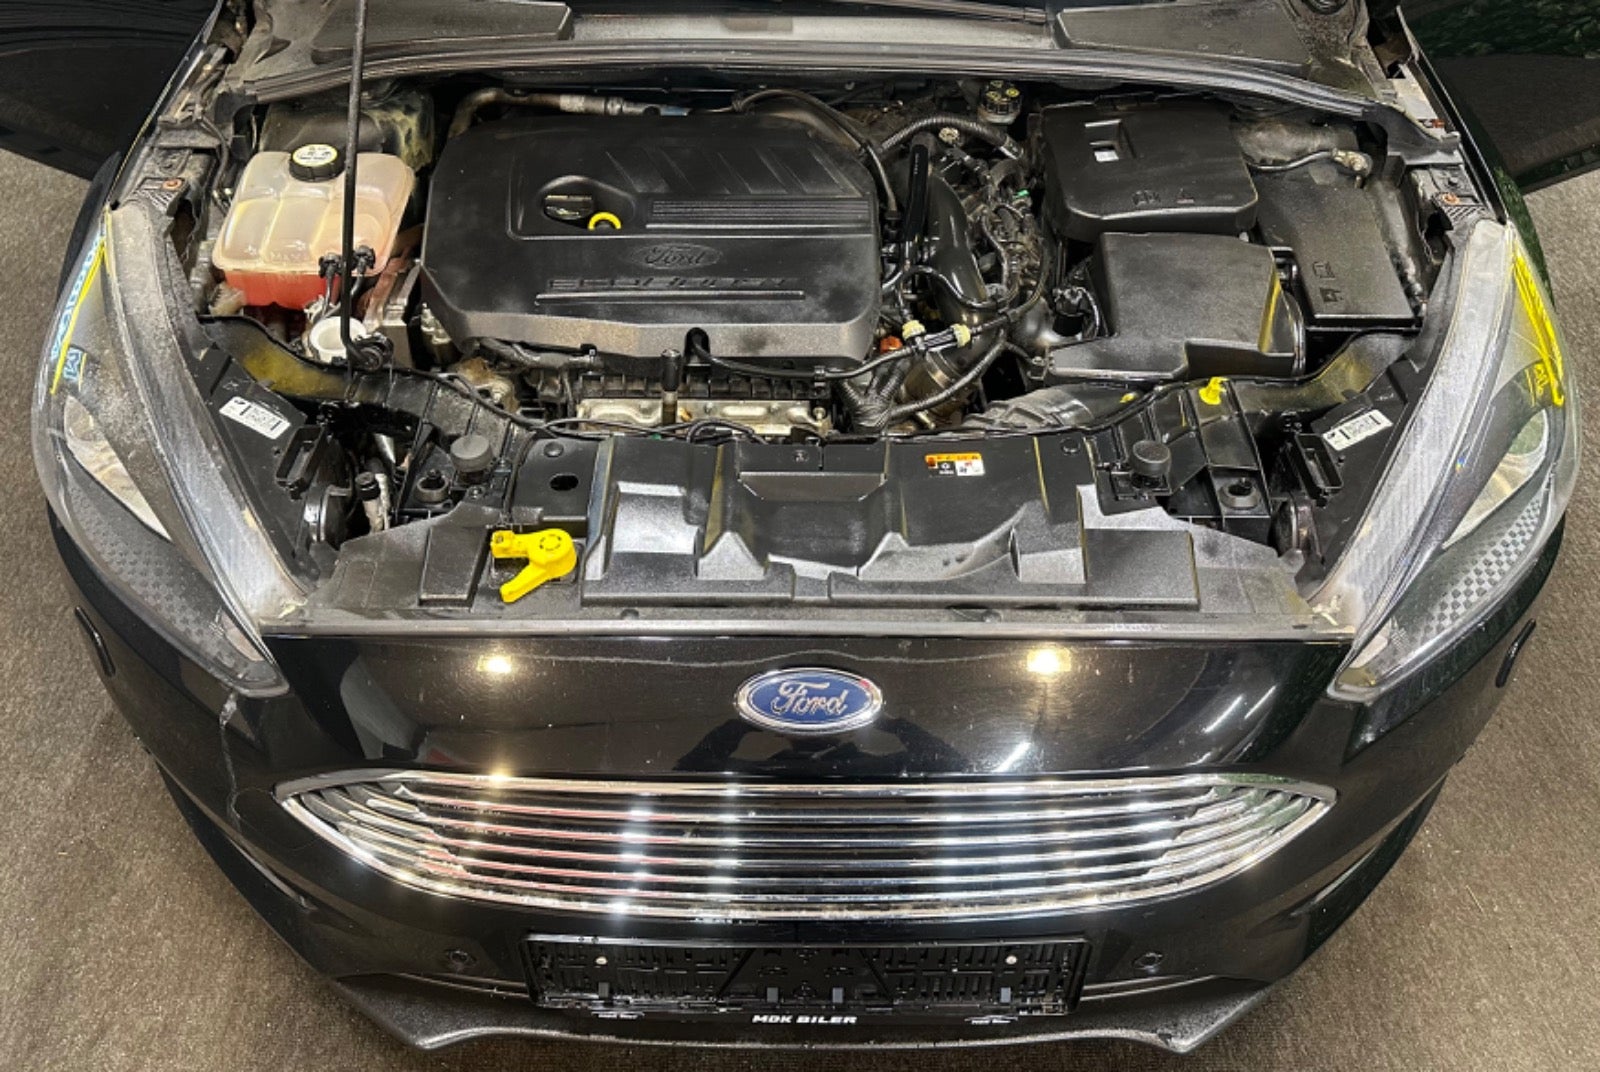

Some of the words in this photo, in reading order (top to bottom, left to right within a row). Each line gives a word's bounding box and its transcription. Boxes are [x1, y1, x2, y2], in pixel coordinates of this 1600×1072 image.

[645, 246, 706, 265] Ford
[770, 681, 849, 716] Ford
[752, 1014, 793, 1024] MDK
[796, 1015, 858, 1025] BILER
